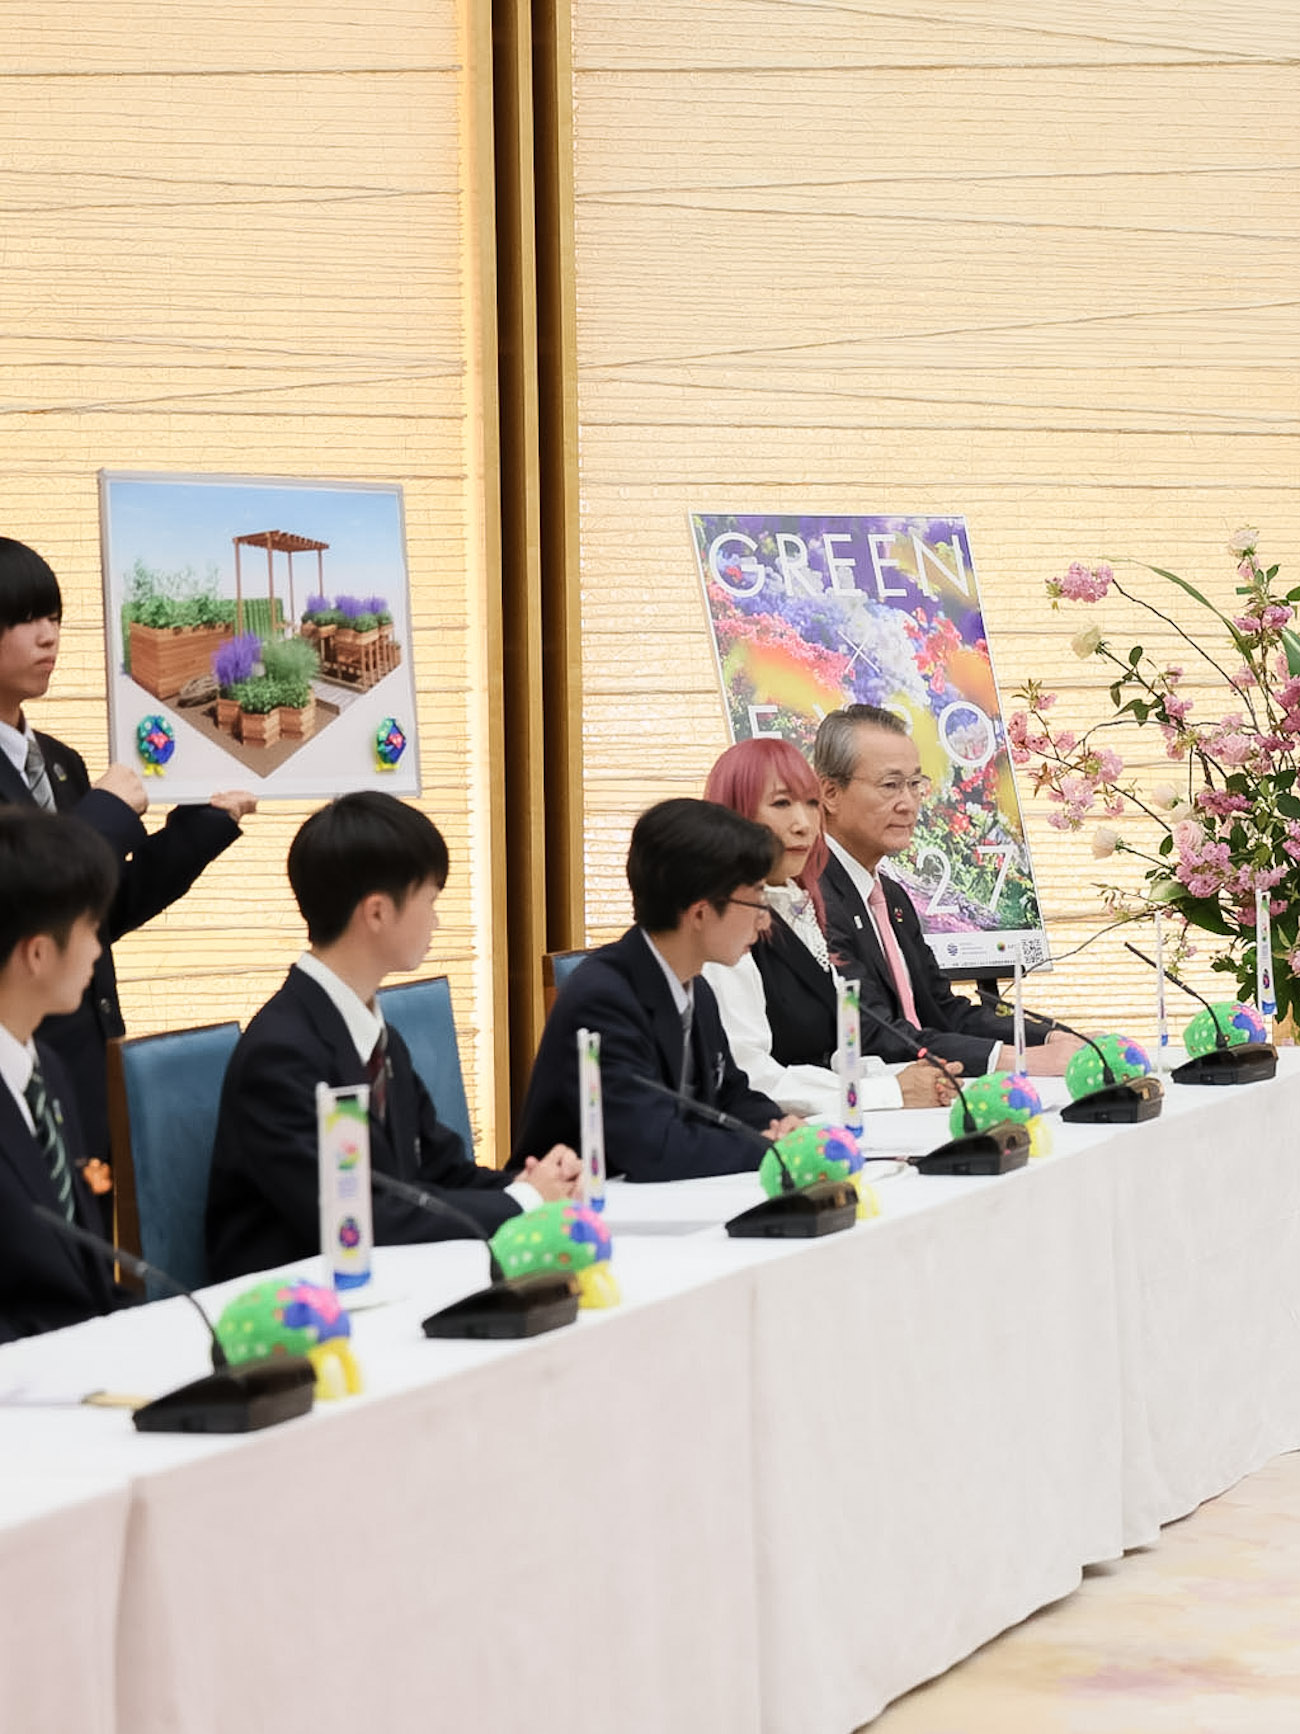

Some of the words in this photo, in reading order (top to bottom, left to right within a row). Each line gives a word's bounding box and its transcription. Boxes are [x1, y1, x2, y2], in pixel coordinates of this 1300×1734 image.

[709, 531, 970, 597] GREEN
[748, 700, 996, 767] EO
[916, 843, 1018, 916] 27
